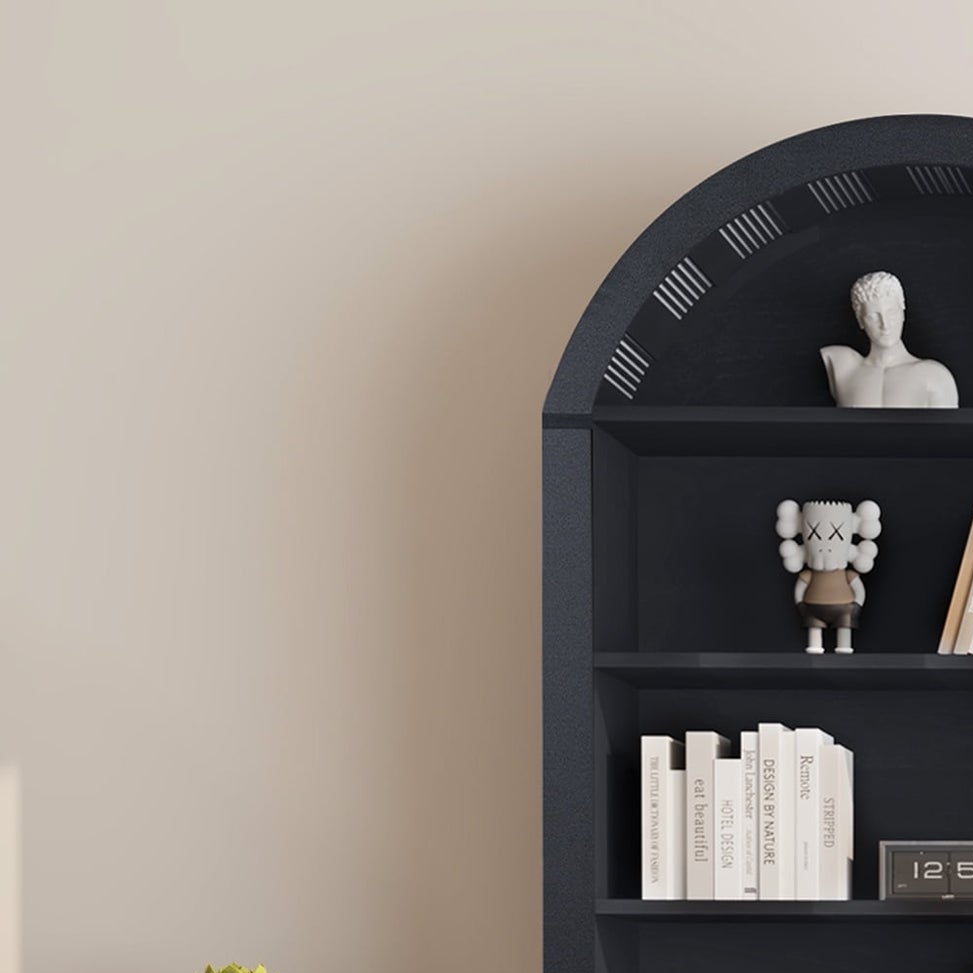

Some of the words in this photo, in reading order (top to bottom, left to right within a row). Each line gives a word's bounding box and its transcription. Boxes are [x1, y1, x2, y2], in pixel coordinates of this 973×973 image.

[745, 749, 756, 770] John
[763, 758, 775, 800] DESIGN
[800, 755, 814, 800] Remote
[694, 778, 705, 798] eat
[745, 772, 756, 819] Lanchester
[720, 799, 734, 829] HOTEL
[763, 804, 775, 817] BY
[823, 797, 834, 848] STRIPPED
[694, 803, 708, 862] beautiful
[720, 833, 734, 869] DESIGN
[763, 820, 775, 865] NATURE
